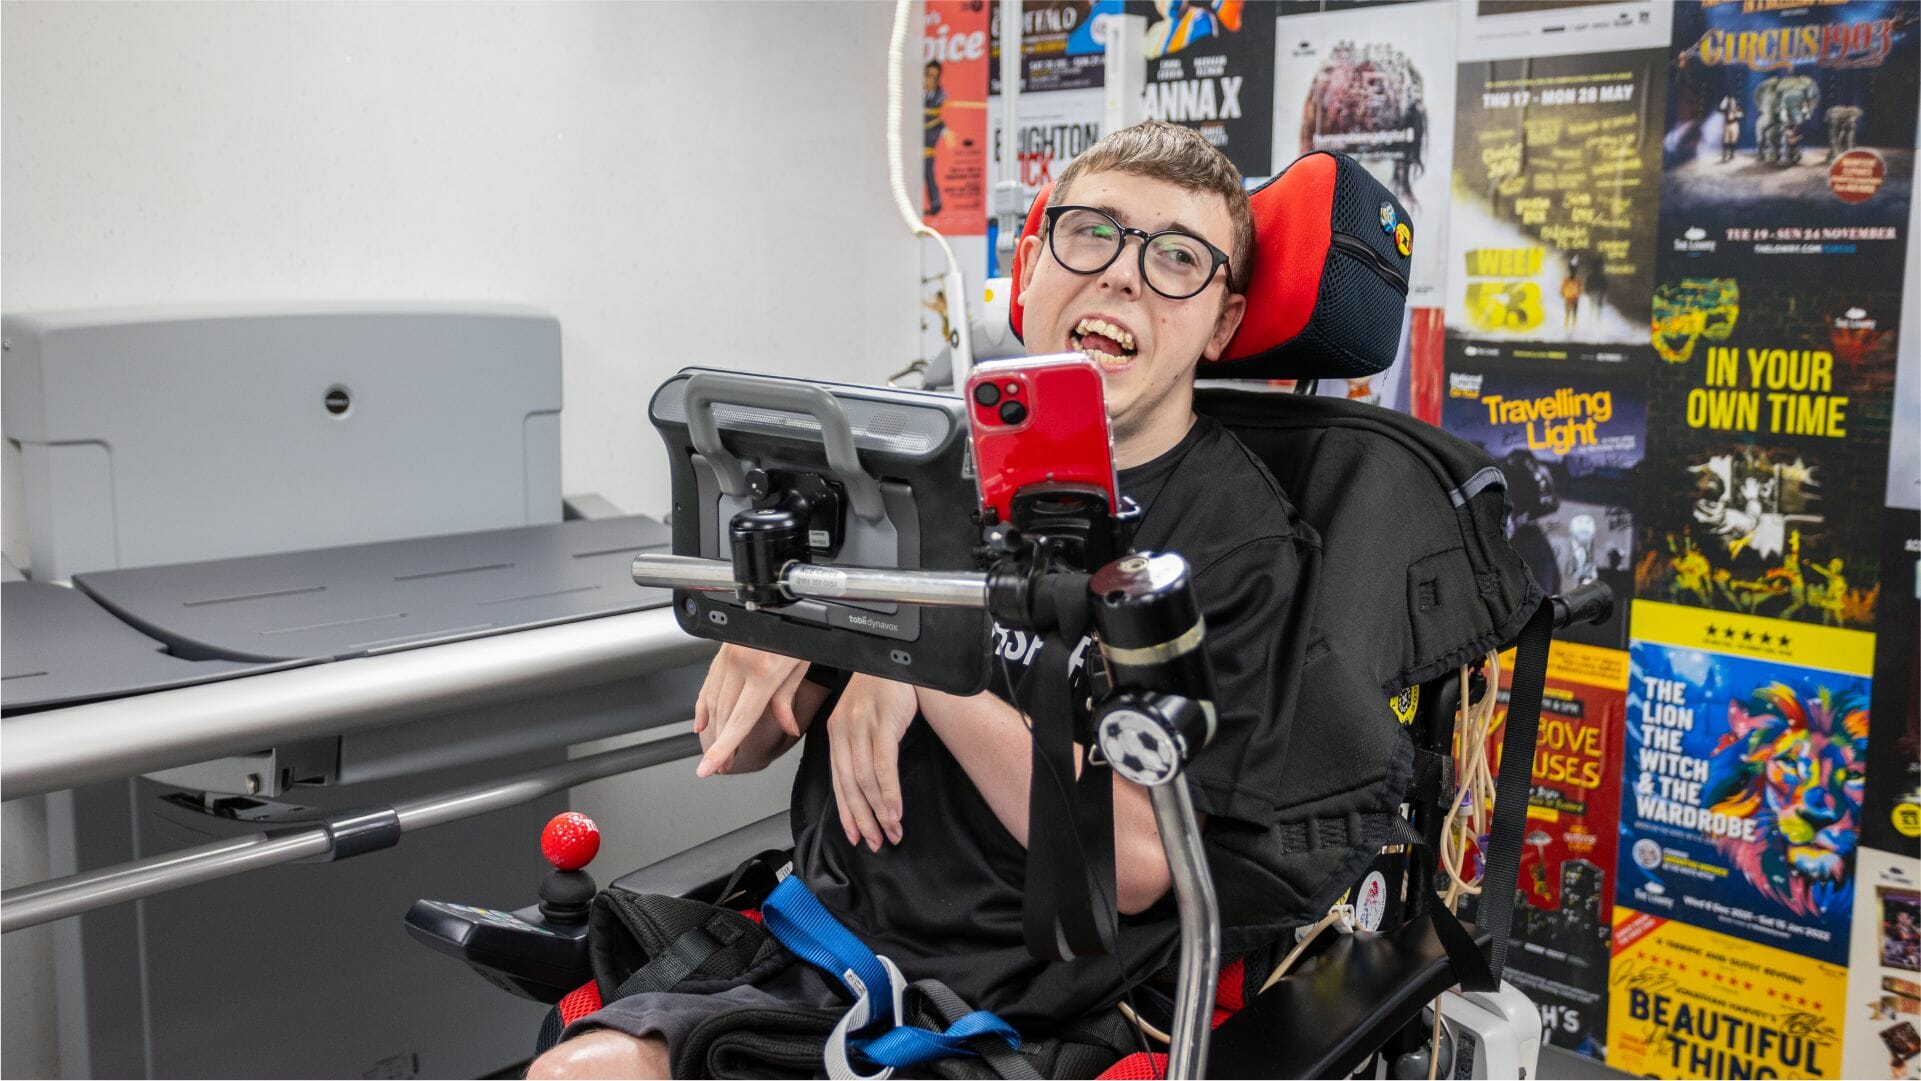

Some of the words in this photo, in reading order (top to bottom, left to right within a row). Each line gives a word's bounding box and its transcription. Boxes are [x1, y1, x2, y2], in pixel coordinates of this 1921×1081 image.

[1701, 24, 1819, 72] CIRCUS
[1819, 18, 1891, 68] 1903
[1142, 79, 1217, 121] ANNA
[1219, 76, 1243, 119] X
[1483, 92, 1511, 109] THU
[1513, 91, 1530, 107] 17
[1541, 88, 1576, 105] MON
[1599, 84, 1634, 102] MAY
[1725, 228, 1749, 240] TUE
[1753, 228, 1767, 239] 19
[1777, 227, 1802, 240] SUN
[1804, 227, 1821, 239] 24
[1822, 227, 1896, 239] NOVEMBER
[1706, 347, 1739, 387] IN
[1747, 349, 1833, 392] YOUR
[1481, 388, 1612, 425] Travelling
[1687, 388, 1760, 432] OWN
[1766, 393, 1849, 438] TIME
[1526, 417, 1598, 455] Light
[849, 614, 867, 626] tobii
[867, 618, 898, 632] dynavox
[1644, 676, 1686, 705] THE
[1642, 701, 1694, 731] LION
[1537, 717, 1601, 757] BOVE
[1641, 724, 1683, 754] THE
[1533, 752, 1601, 789] USES
[1639, 748, 1709, 783] WITCH
[1638, 771, 1655, 794] &
[1659, 776, 1702, 806] THE
[1636, 795, 1758, 843] WARDROBE
[1629, 988, 1824, 1077] BEAUTIFUL
